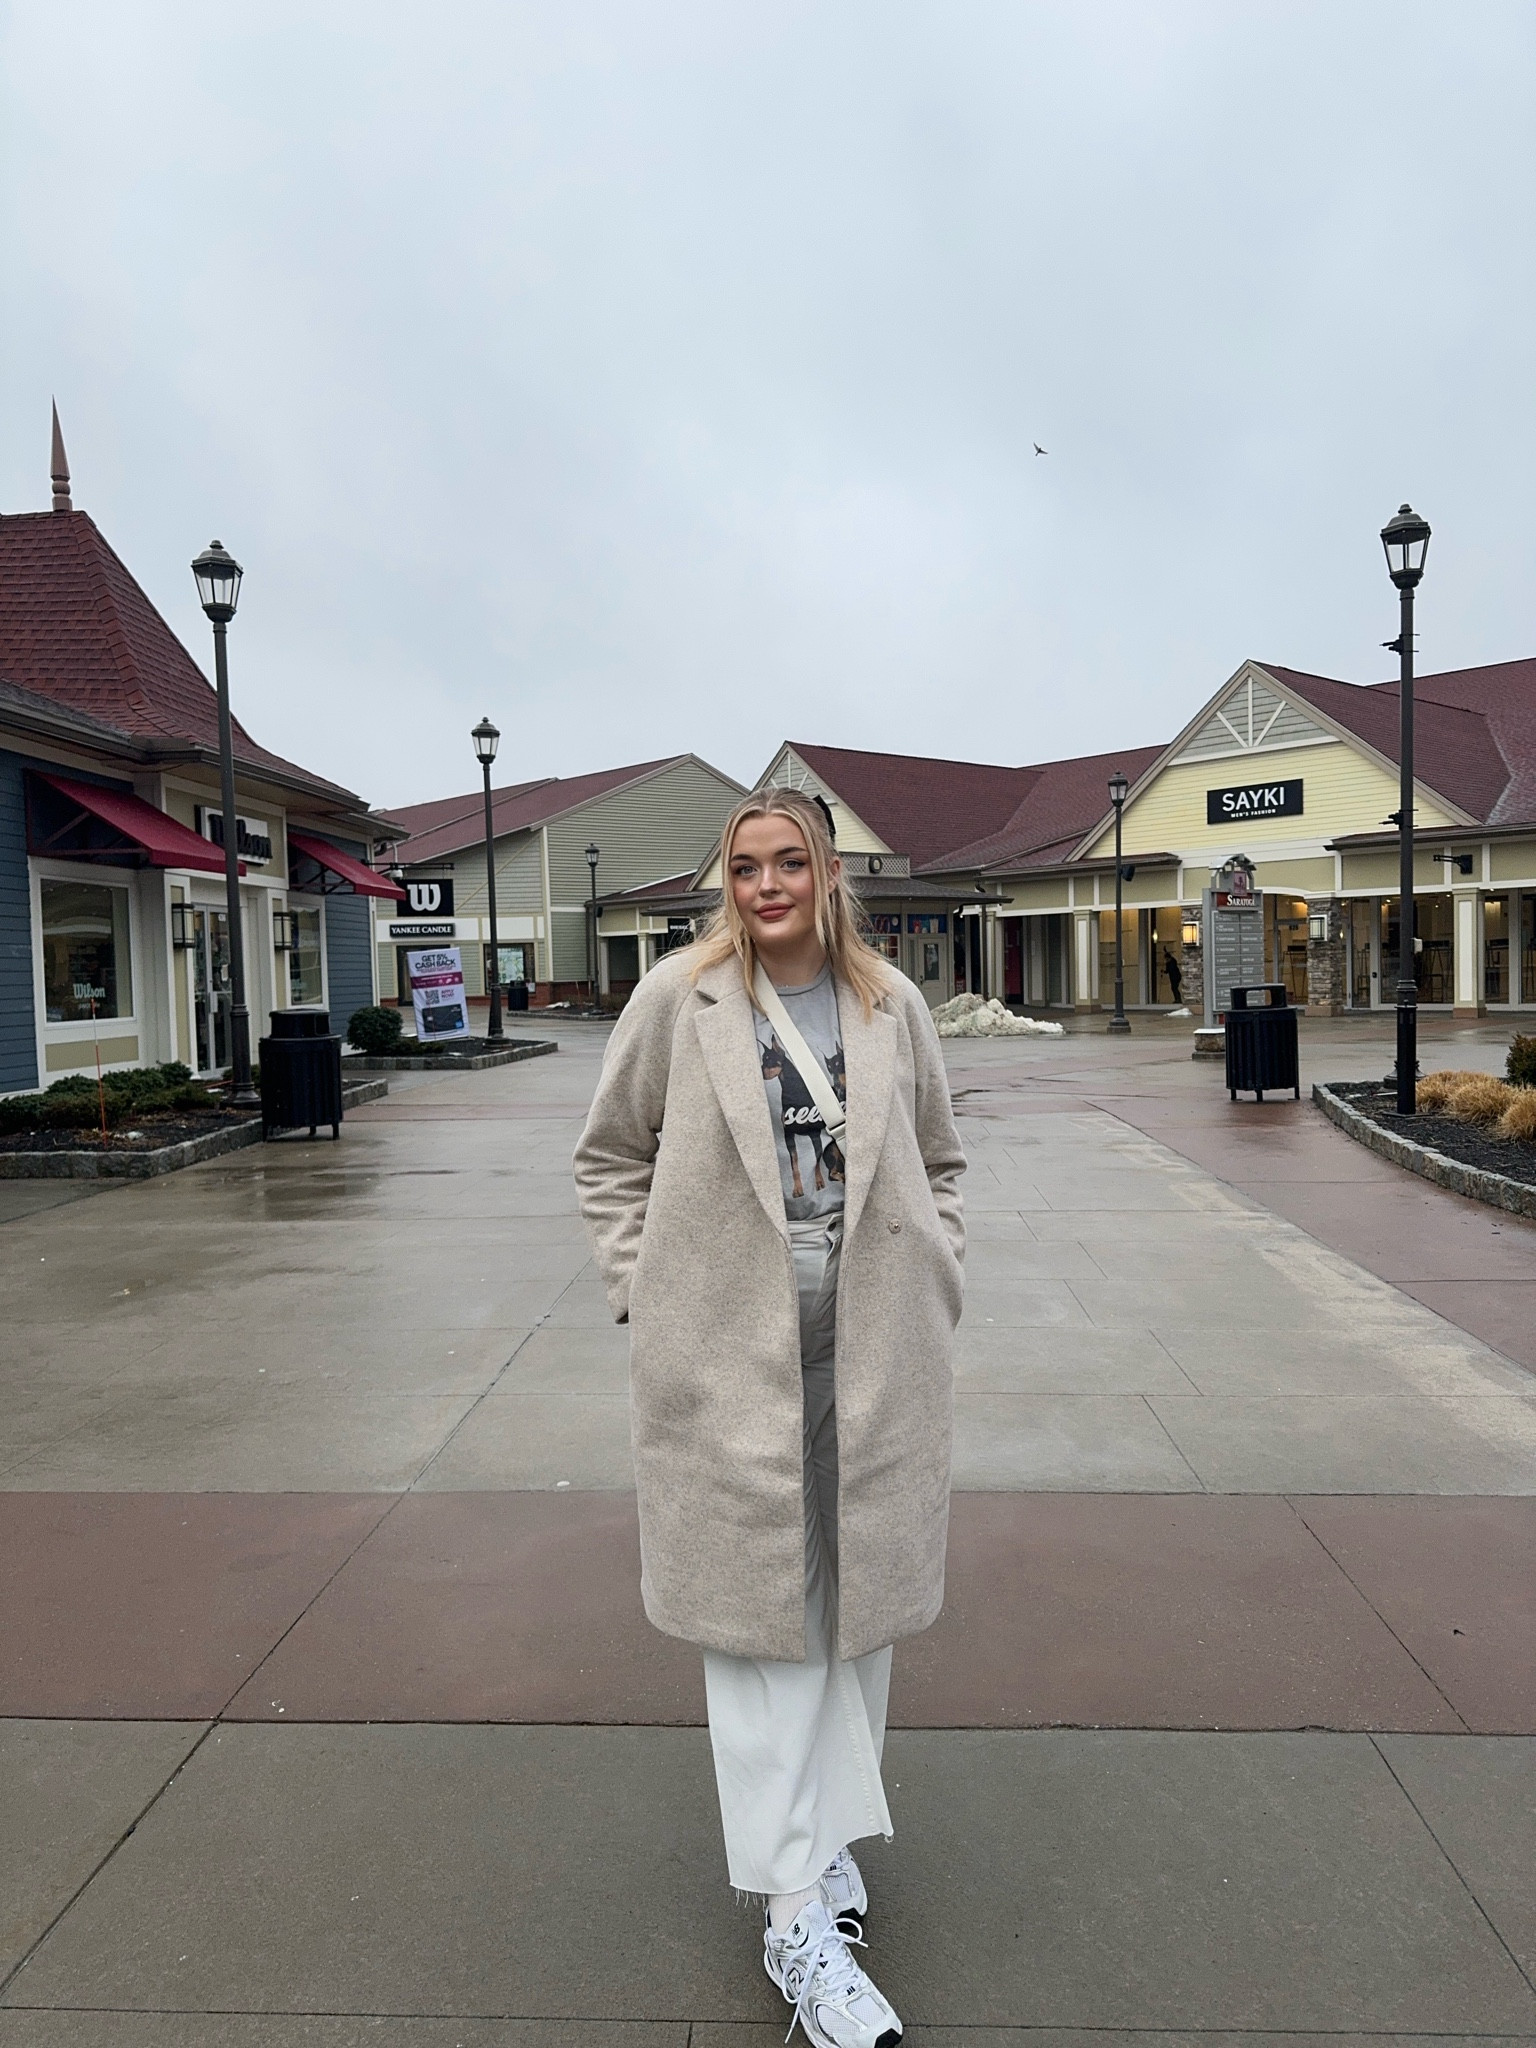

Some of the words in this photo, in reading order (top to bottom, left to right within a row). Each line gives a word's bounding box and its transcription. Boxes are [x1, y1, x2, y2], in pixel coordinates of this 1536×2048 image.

[1222, 786, 1285, 811] SAYKI
[1250, 808, 1276, 816] FASHION
[208, 814, 272, 859] Wlson
[415, 961, 436, 969] CASH
[437, 959, 456, 967] BACK
[422, 954, 435, 962] GET
[73, 983, 106, 999] Wilson
